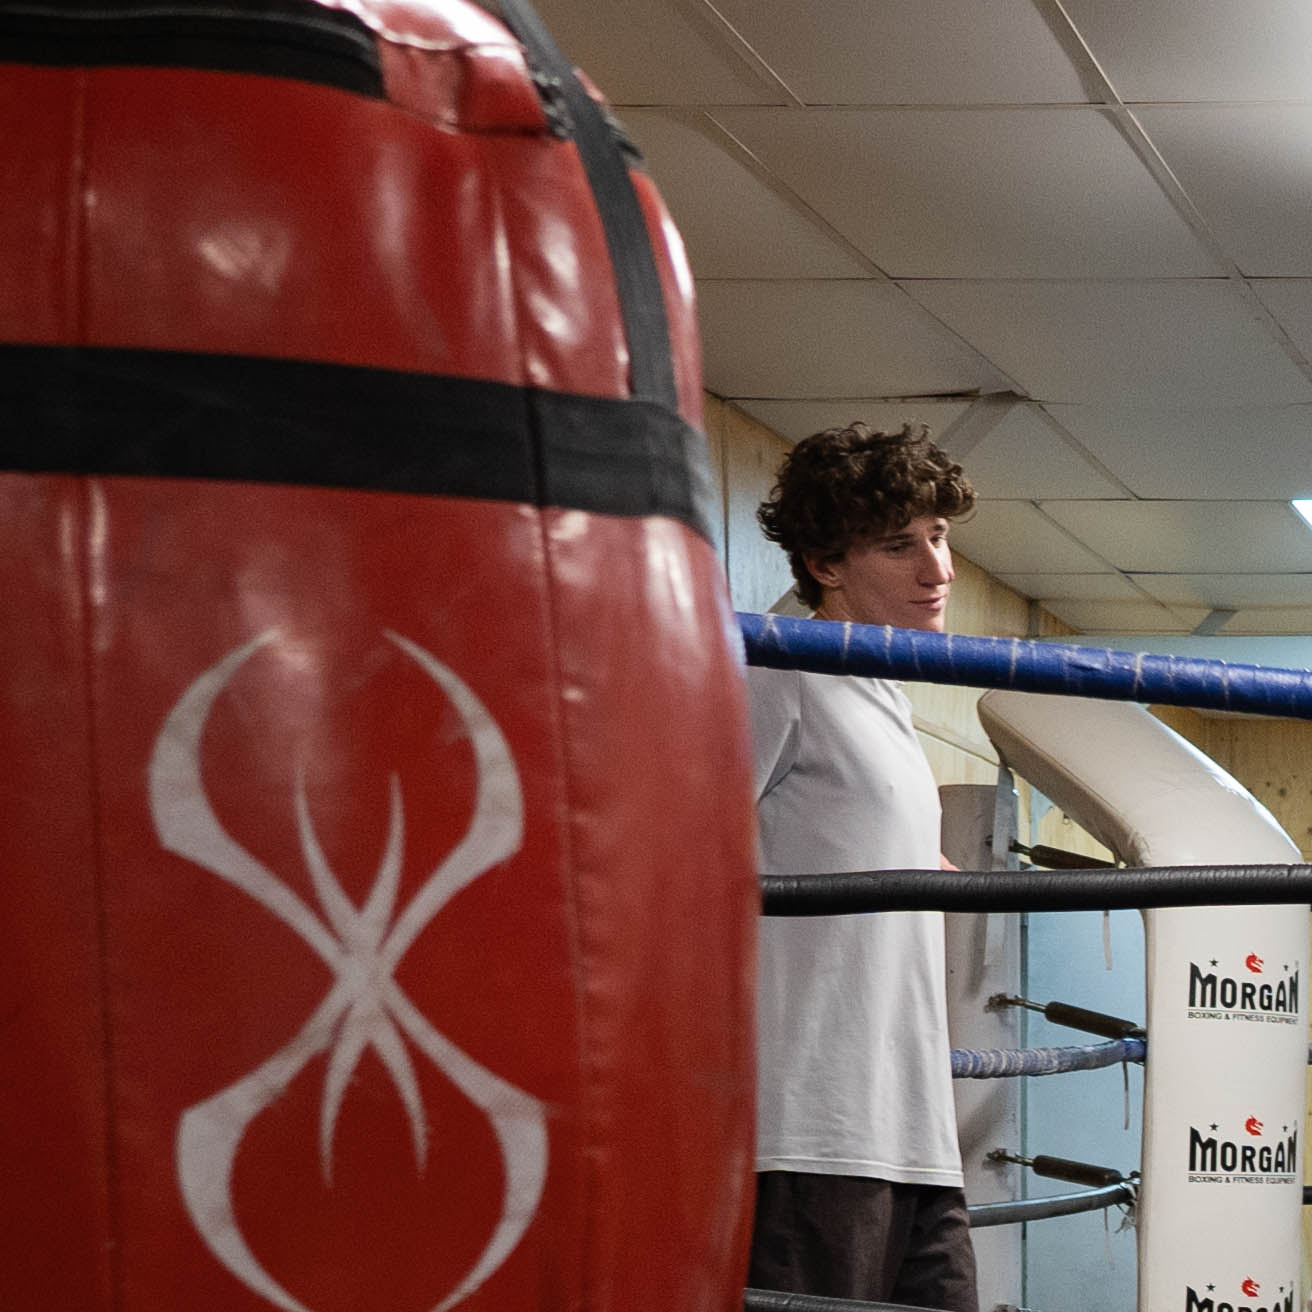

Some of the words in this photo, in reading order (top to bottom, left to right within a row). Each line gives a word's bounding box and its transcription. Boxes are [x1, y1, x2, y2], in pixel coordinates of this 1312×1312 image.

[1188, 962, 1299, 1014] MORGAN
[1187, 1011, 1222, 1020] BOXING
[1232, 1014, 1264, 1023] FITNESS
[1188, 1127, 1298, 1173] MORGAN
[1187, 1175, 1222, 1184] BOXING
